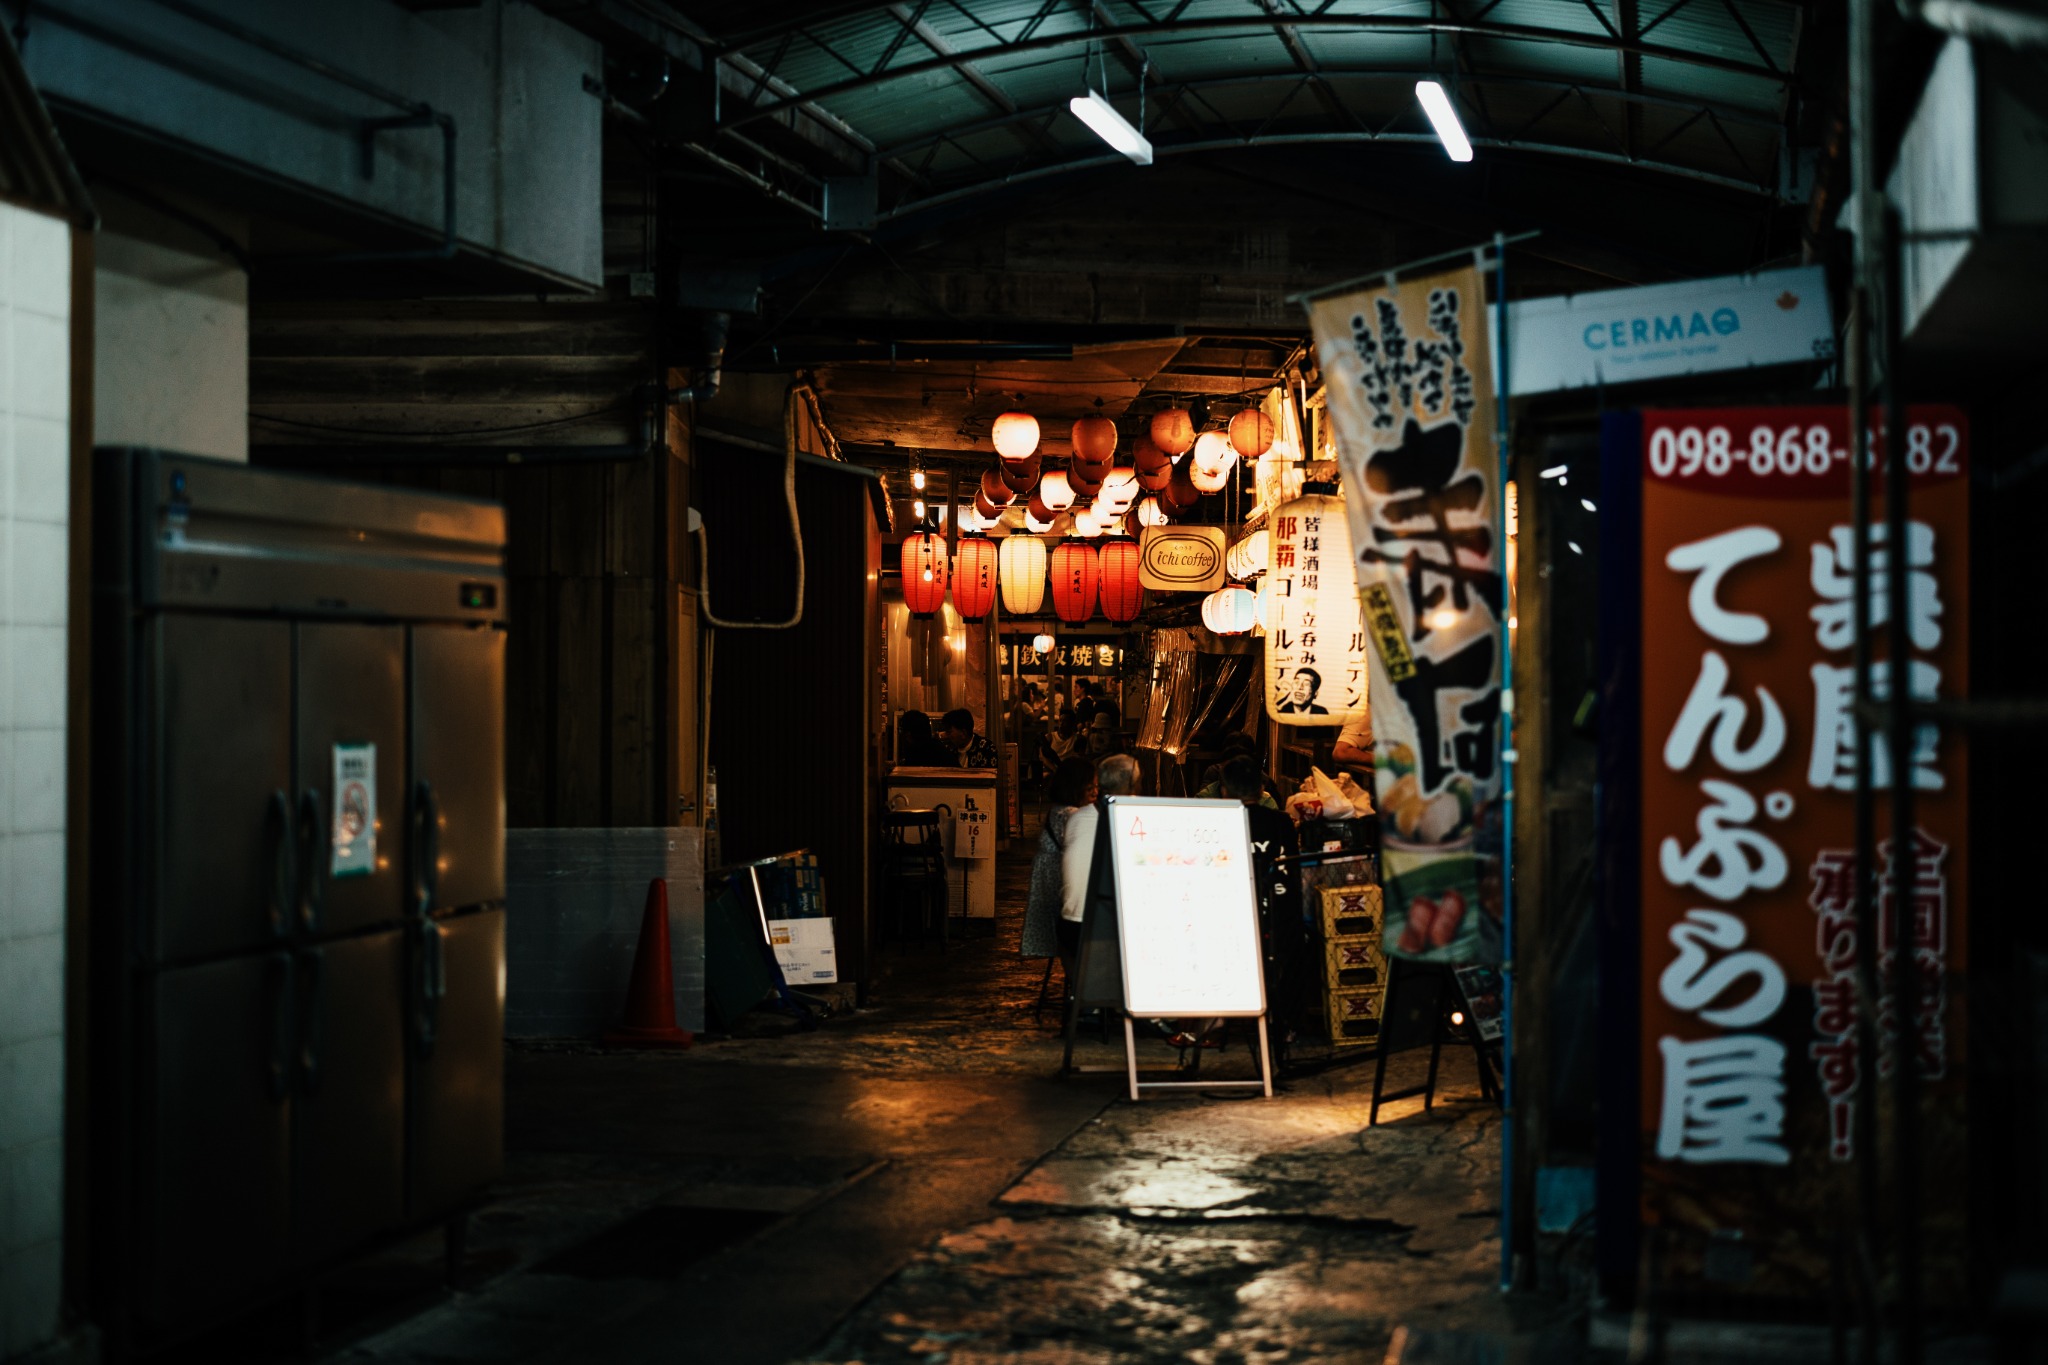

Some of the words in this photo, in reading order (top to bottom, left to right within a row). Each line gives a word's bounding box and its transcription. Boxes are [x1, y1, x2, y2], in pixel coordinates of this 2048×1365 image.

[1649, 424, 1960, 477] 098-868-882
[1157, 550, 1178, 566] ichi
[1181, 552, 1213, 567] coffee
[1302, 516, 1321, 591] 皆様酒場
[1300, 611, 1317, 665] 立呑み
[968, 825, 980, 836] 16
[1657, 525, 1795, 1164] てんぷら屋
